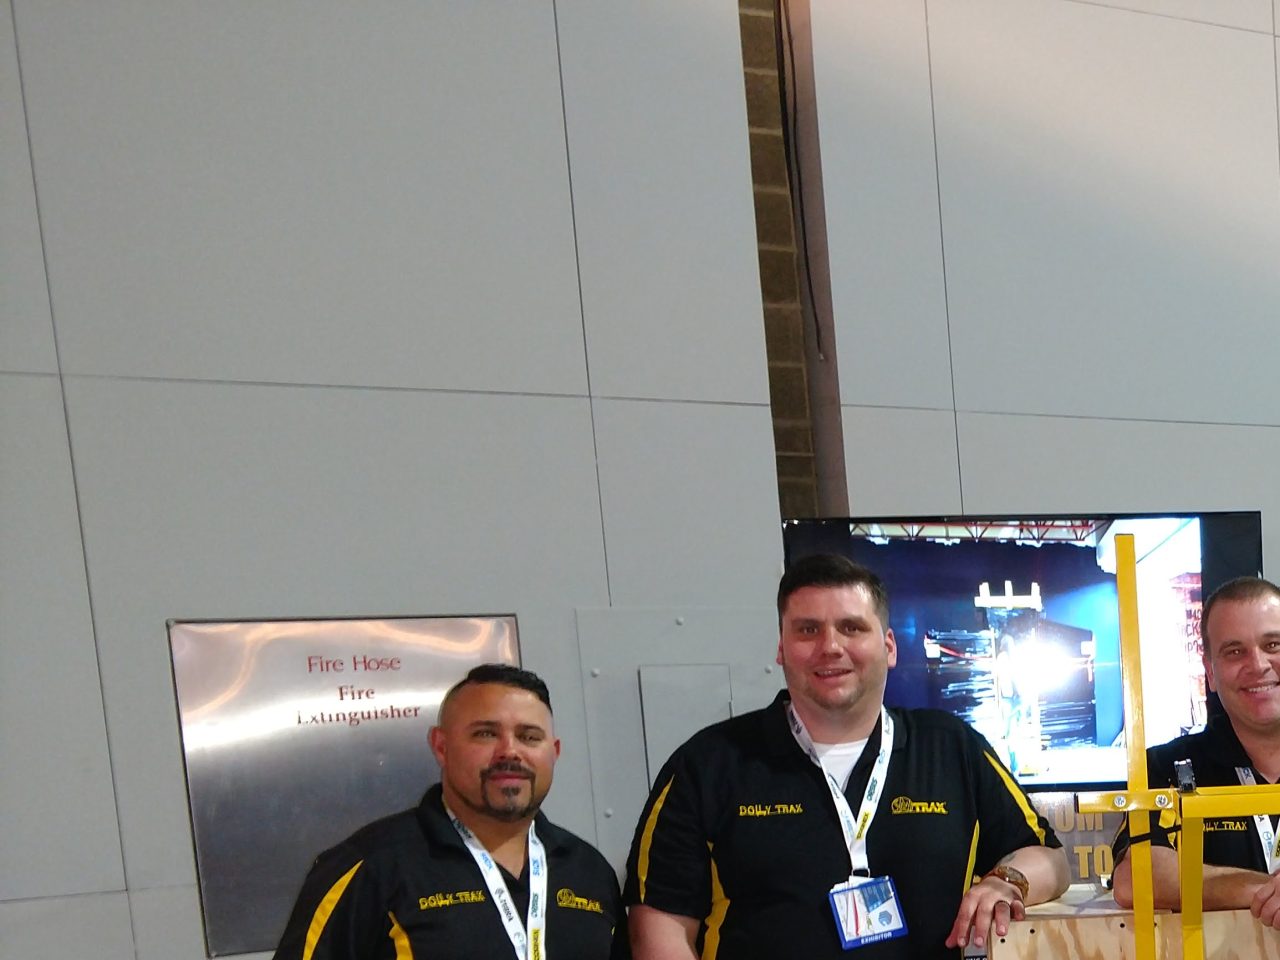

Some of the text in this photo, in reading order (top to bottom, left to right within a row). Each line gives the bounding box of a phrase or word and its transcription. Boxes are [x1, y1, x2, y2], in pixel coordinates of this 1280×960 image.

[307, 655, 401, 672] Fire Hose
[338, 685, 376, 701] Fire
